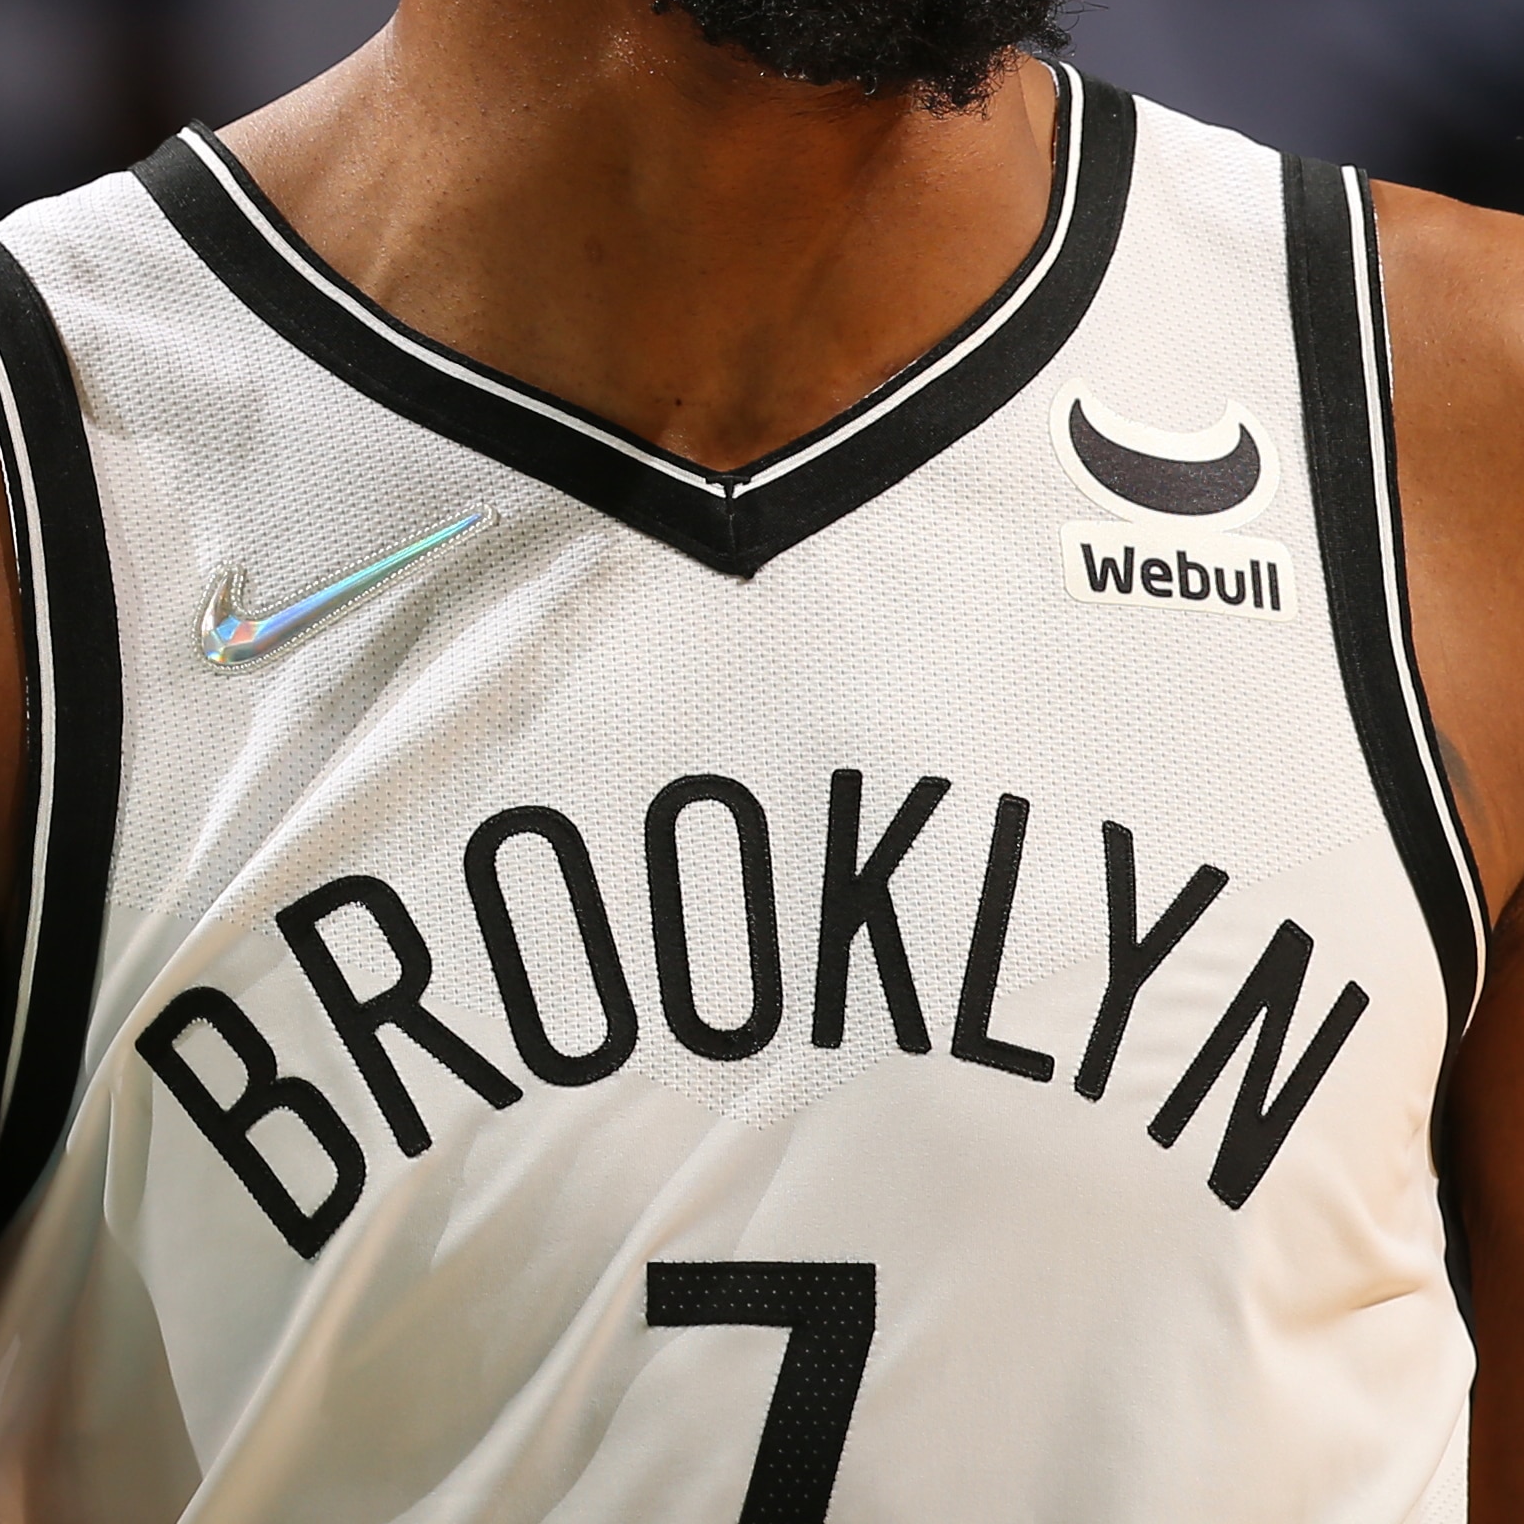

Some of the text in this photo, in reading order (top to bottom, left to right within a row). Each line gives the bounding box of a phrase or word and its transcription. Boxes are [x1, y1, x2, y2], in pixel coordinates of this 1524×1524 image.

[1080, 542, 1281, 611] Webull
[135, 768, 1370, 1260] BROOKLYN
[645, 1261, 877, 1524] 7
